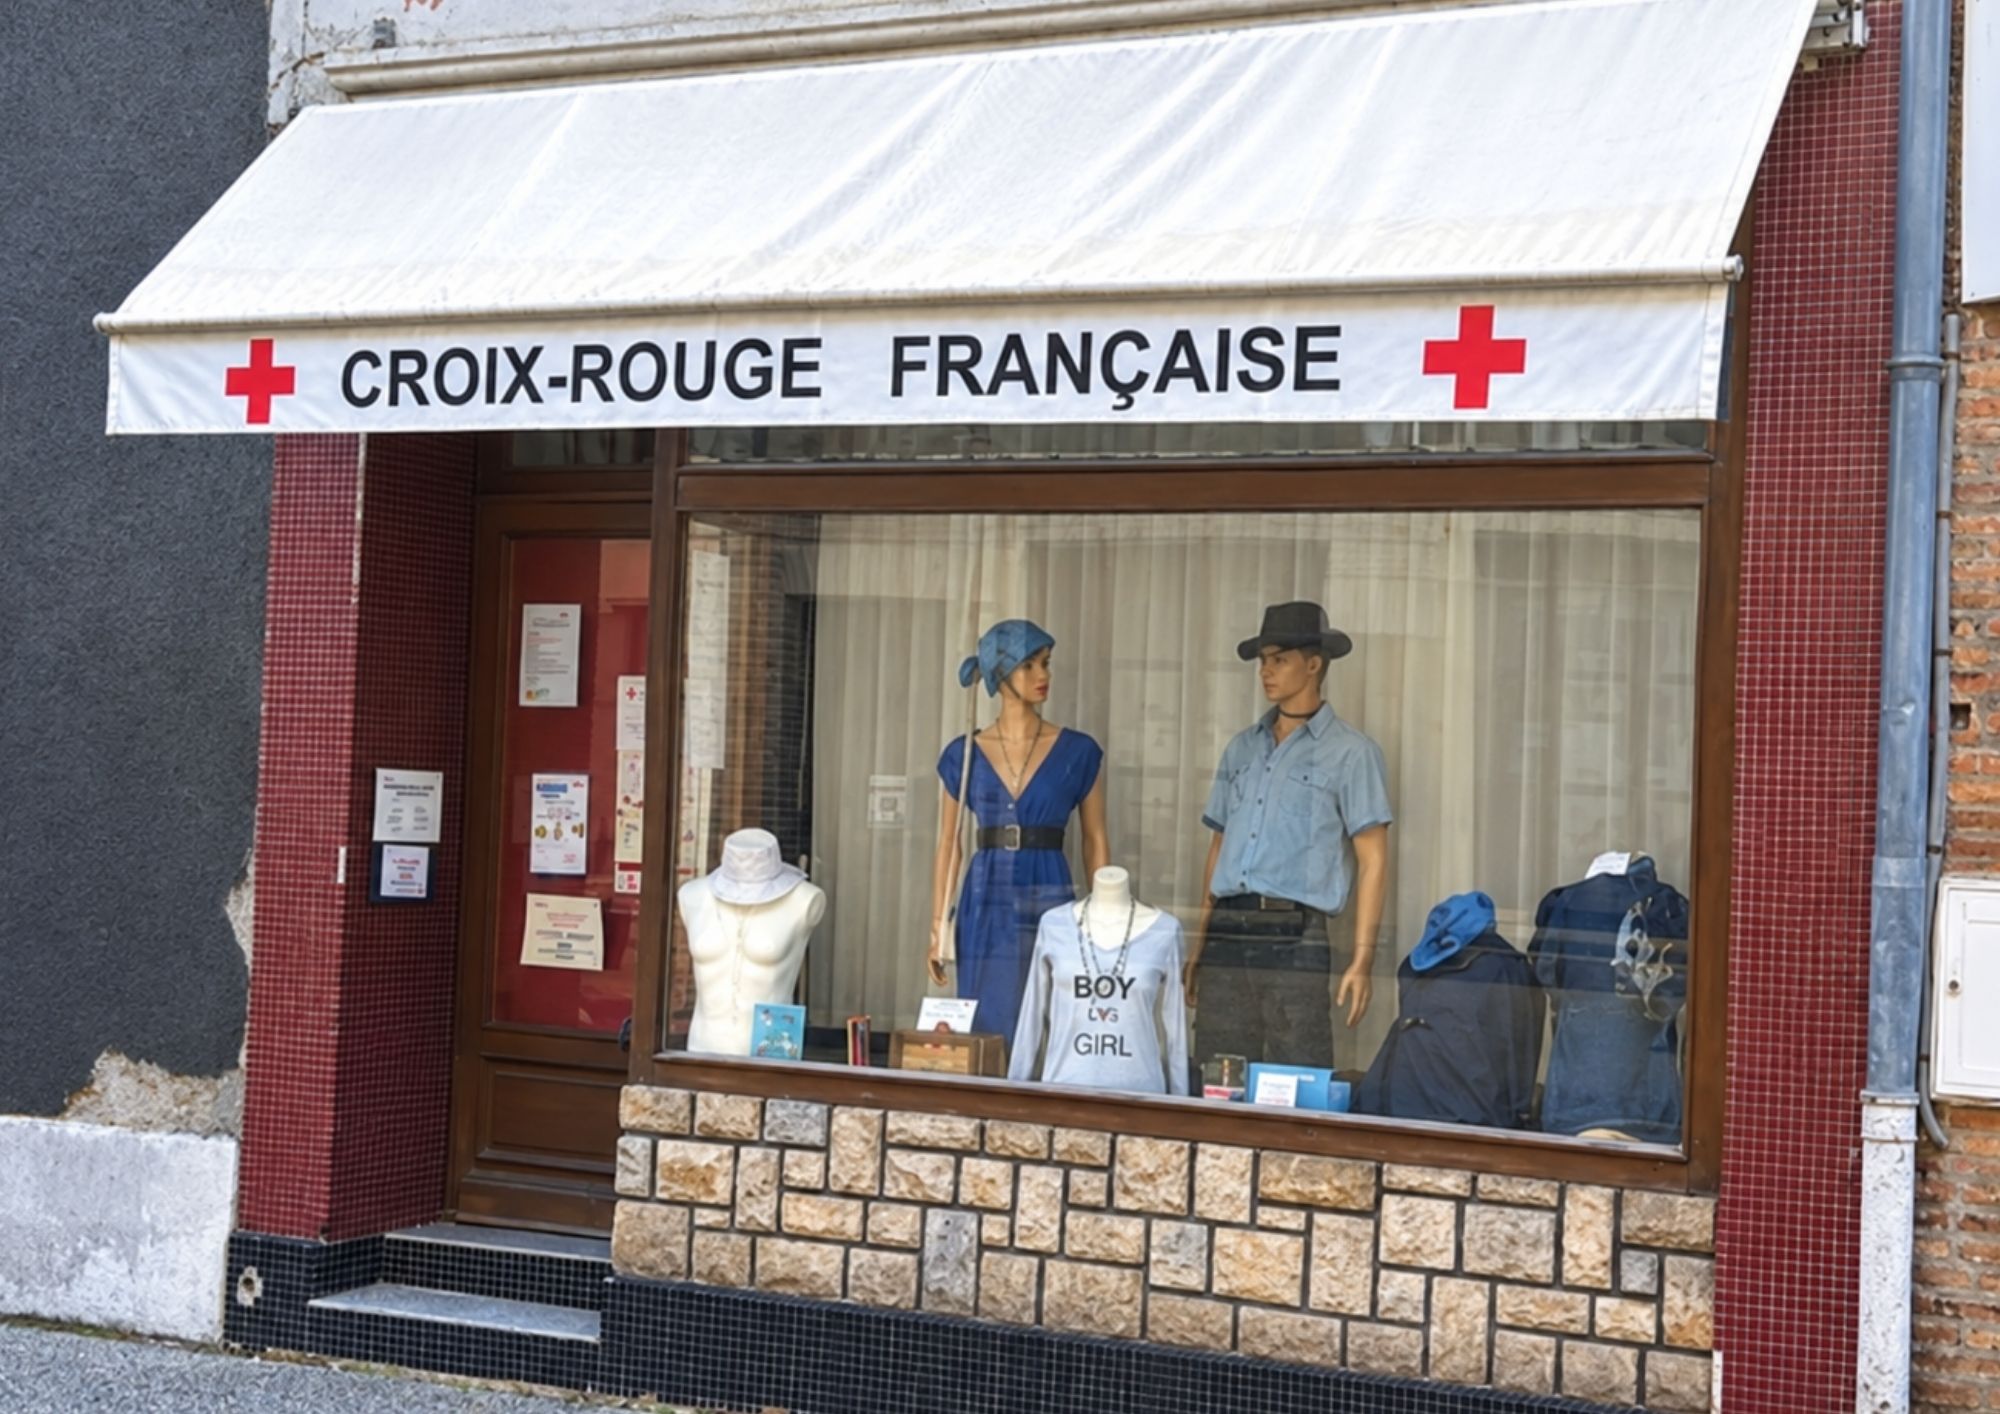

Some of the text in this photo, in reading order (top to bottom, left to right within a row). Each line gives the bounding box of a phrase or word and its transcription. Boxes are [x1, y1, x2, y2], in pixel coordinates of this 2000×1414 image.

[341, 325, 1342, 410] CROIX-ROUGE FRANÇAISE
[1074, 975, 1136, 1000] BOY
[1074, 1032, 1132, 1057] GIRL
